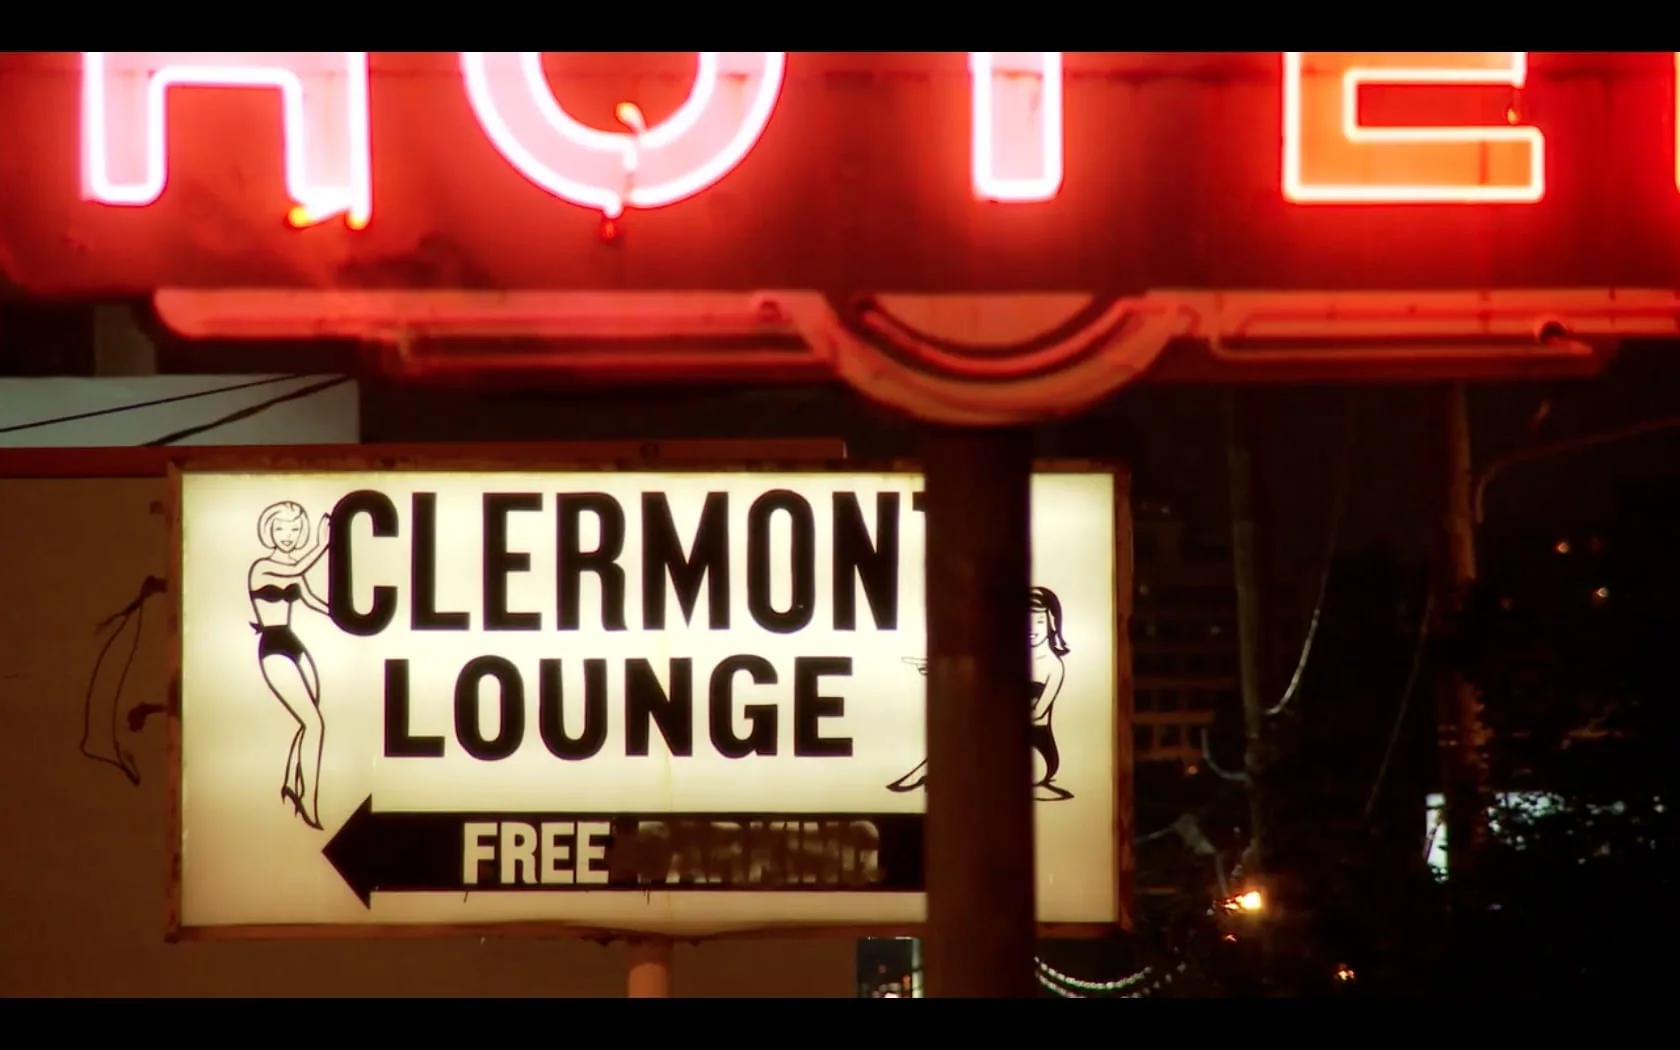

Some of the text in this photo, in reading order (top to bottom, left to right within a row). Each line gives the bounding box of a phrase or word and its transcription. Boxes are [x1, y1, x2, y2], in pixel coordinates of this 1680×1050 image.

[328, 488, 927, 636] CLERMON
[383, 654, 854, 761] LOUNGE
[463, 821, 612, 884] FREE
